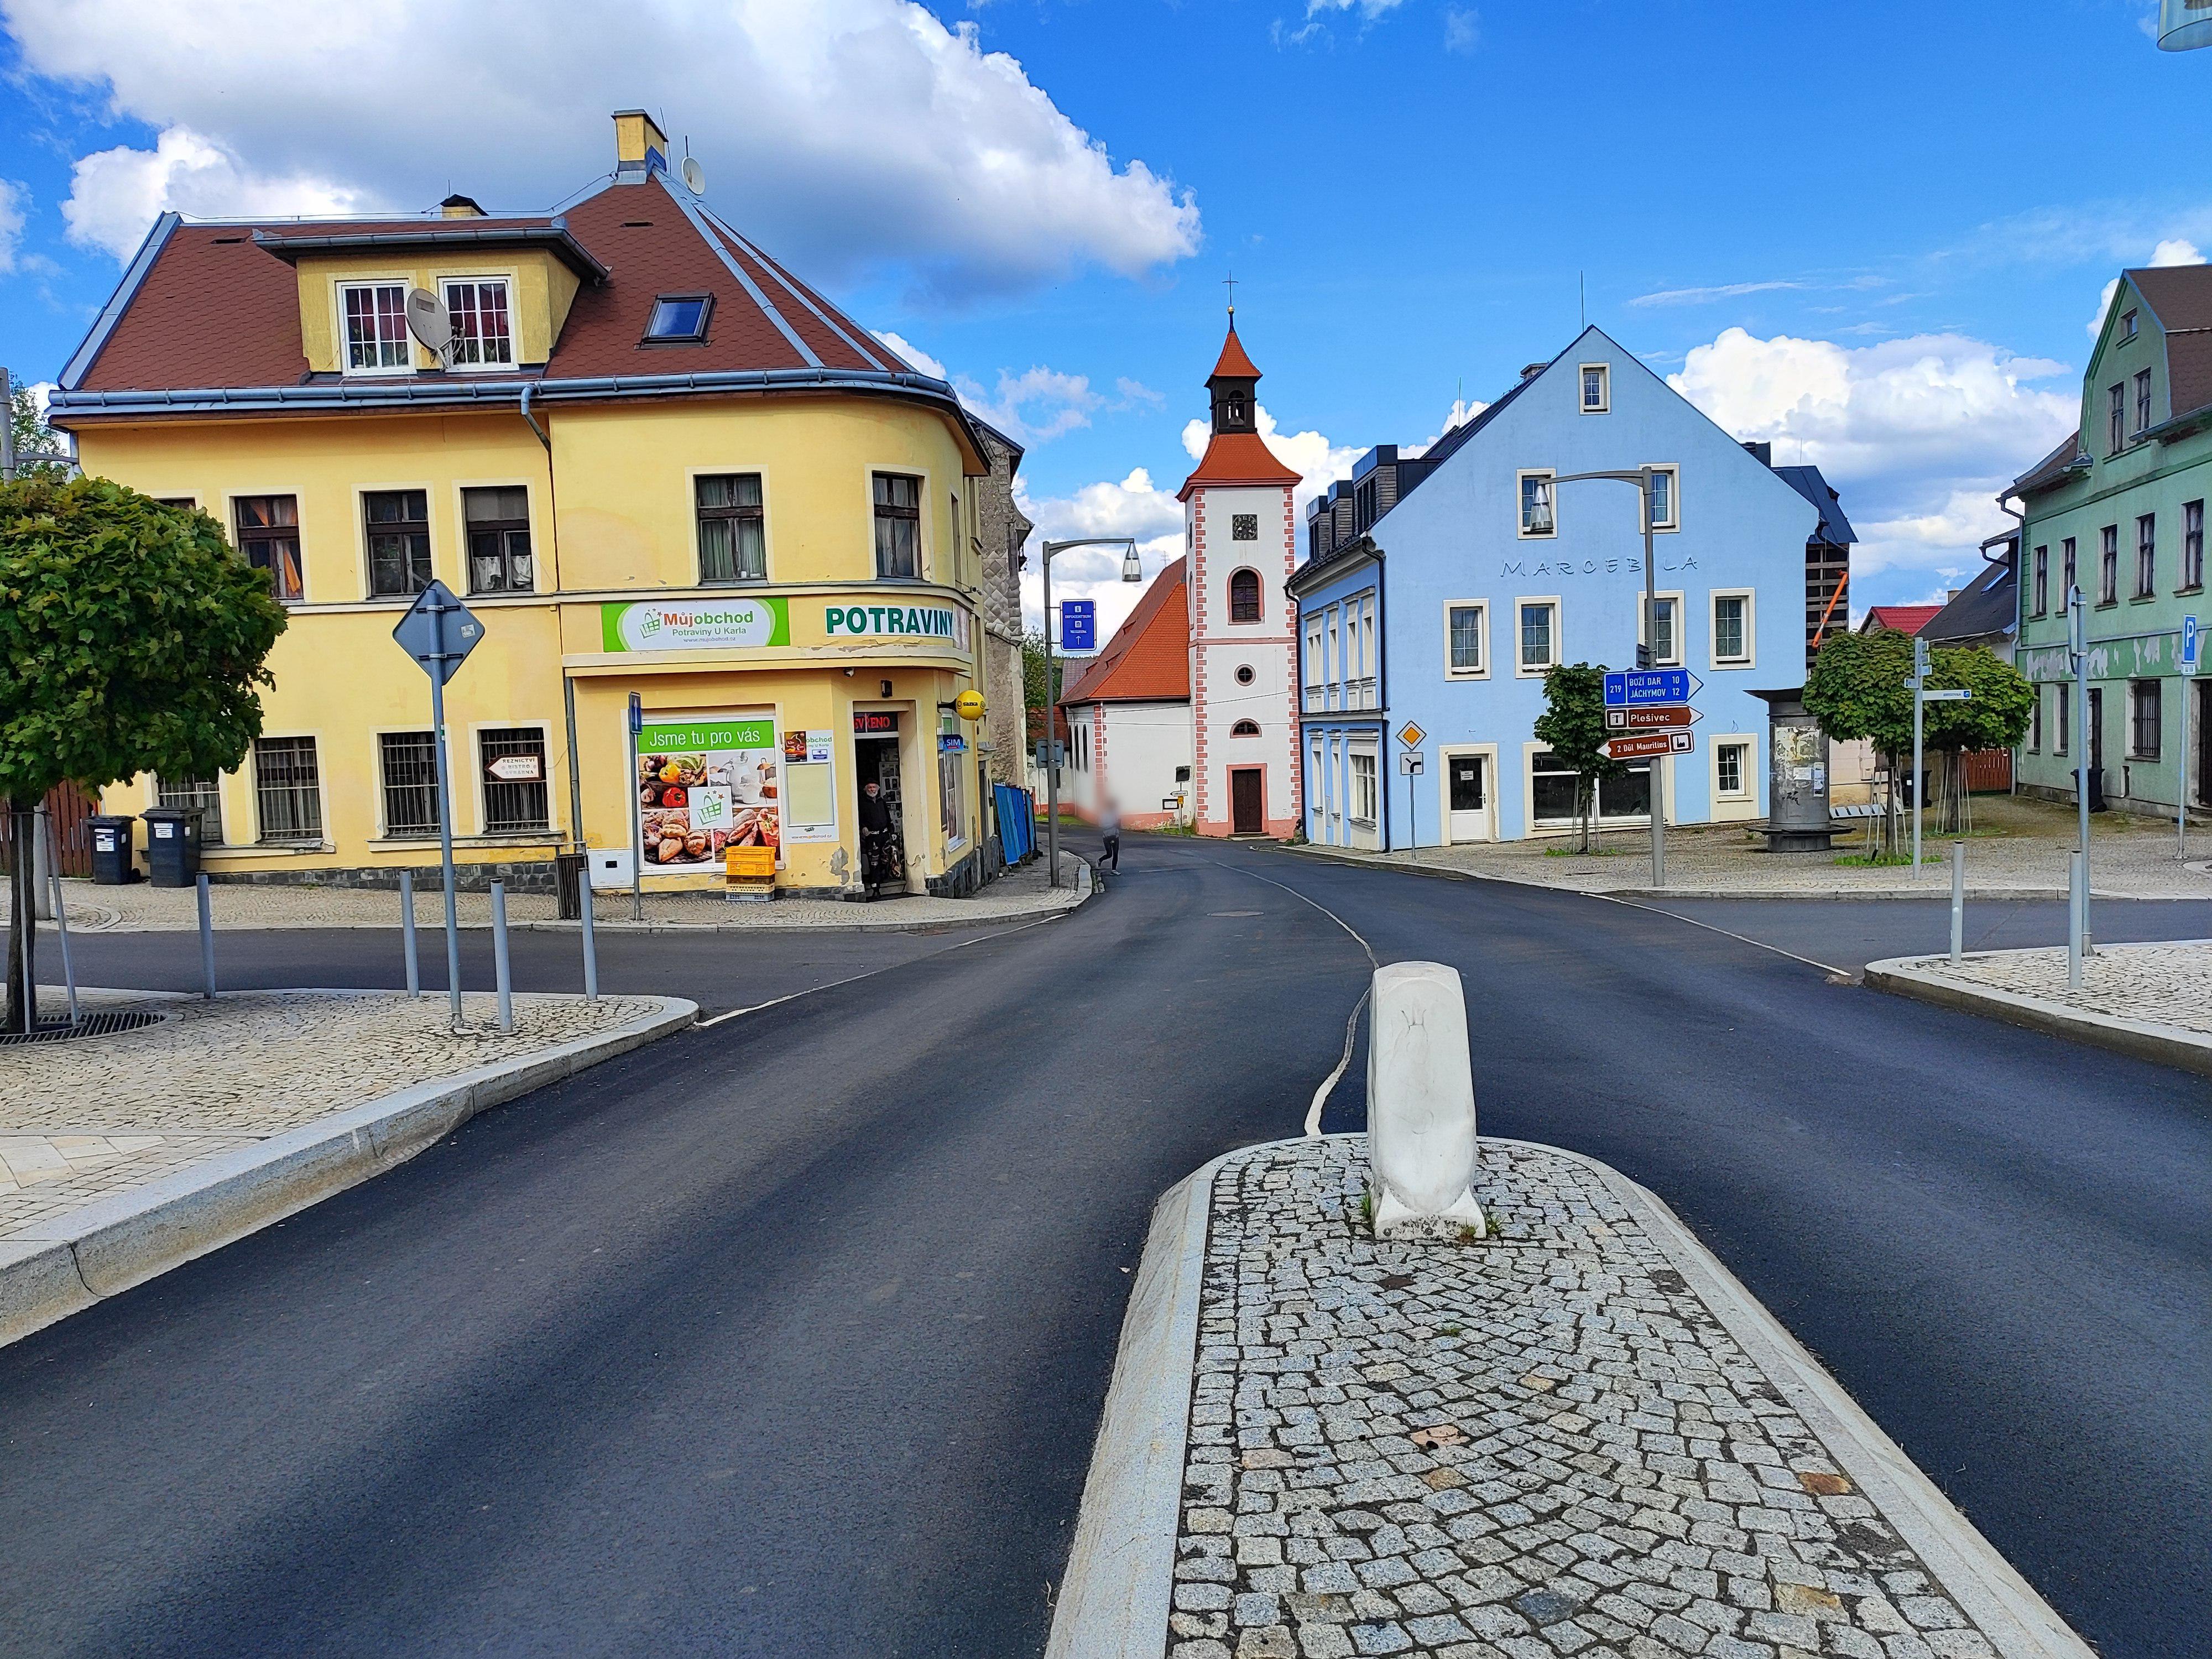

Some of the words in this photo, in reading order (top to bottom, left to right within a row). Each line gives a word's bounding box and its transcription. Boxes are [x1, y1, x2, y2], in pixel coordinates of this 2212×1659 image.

[1500, 556, 1698, 577] MARCEBLA
[664, 611, 754, 628] Můjobchod
[826, 607, 953, 636] POTRAVINY
[672, 628, 712, 637] Potraviny
[1629, 676, 1645, 687] BOŽÍ
[1647, 677, 1661, 686] DAR
[1672, 676, 1680, 684] 10
[1610, 685, 1622, 693] 219
[1630, 688, 1666, 698] JÁCHYMOV
[1672, 687, 1680, 696] 12
[1630, 713, 1670, 723] Plešivec
[649, 731, 686, 747] Jsme
[691, 729, 705, 745] tu
[710, 730, 732, 747] pro
[737, 726, 760, 743] vás
[1617, 744, 1621, 753] 2
[1624, 743, 1634, 752] Důl
[1636, 741, 1667, 751] Mauritius
